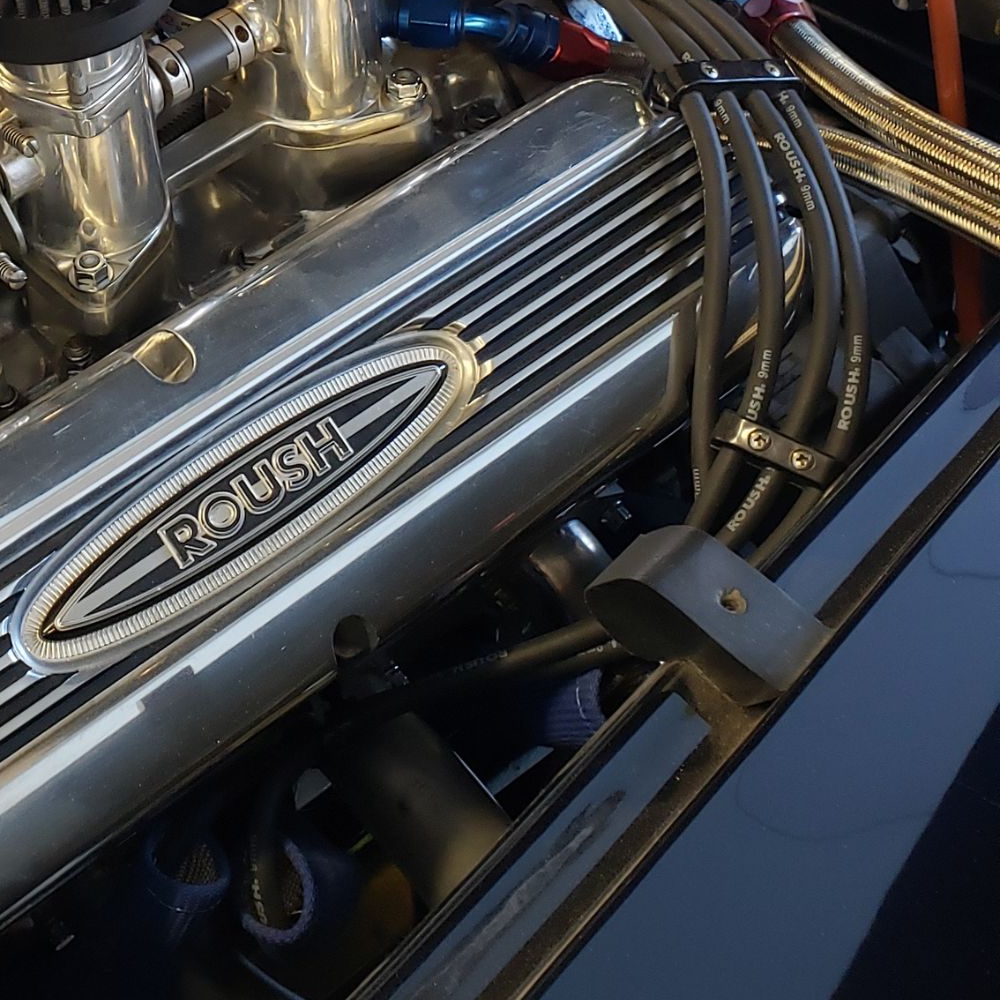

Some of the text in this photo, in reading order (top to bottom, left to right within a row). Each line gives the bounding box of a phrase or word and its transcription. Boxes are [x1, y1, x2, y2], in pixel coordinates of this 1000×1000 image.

[714, 98, 731, 125] 9mm
[785, 104, 803, 129] 9mm
[799, 185, 816, 212] 9mm
[850, 334, 864, 363] 9mm
[757, 349, 773, 379] 9mm
[156, 416, 355, 570] ROUSH
